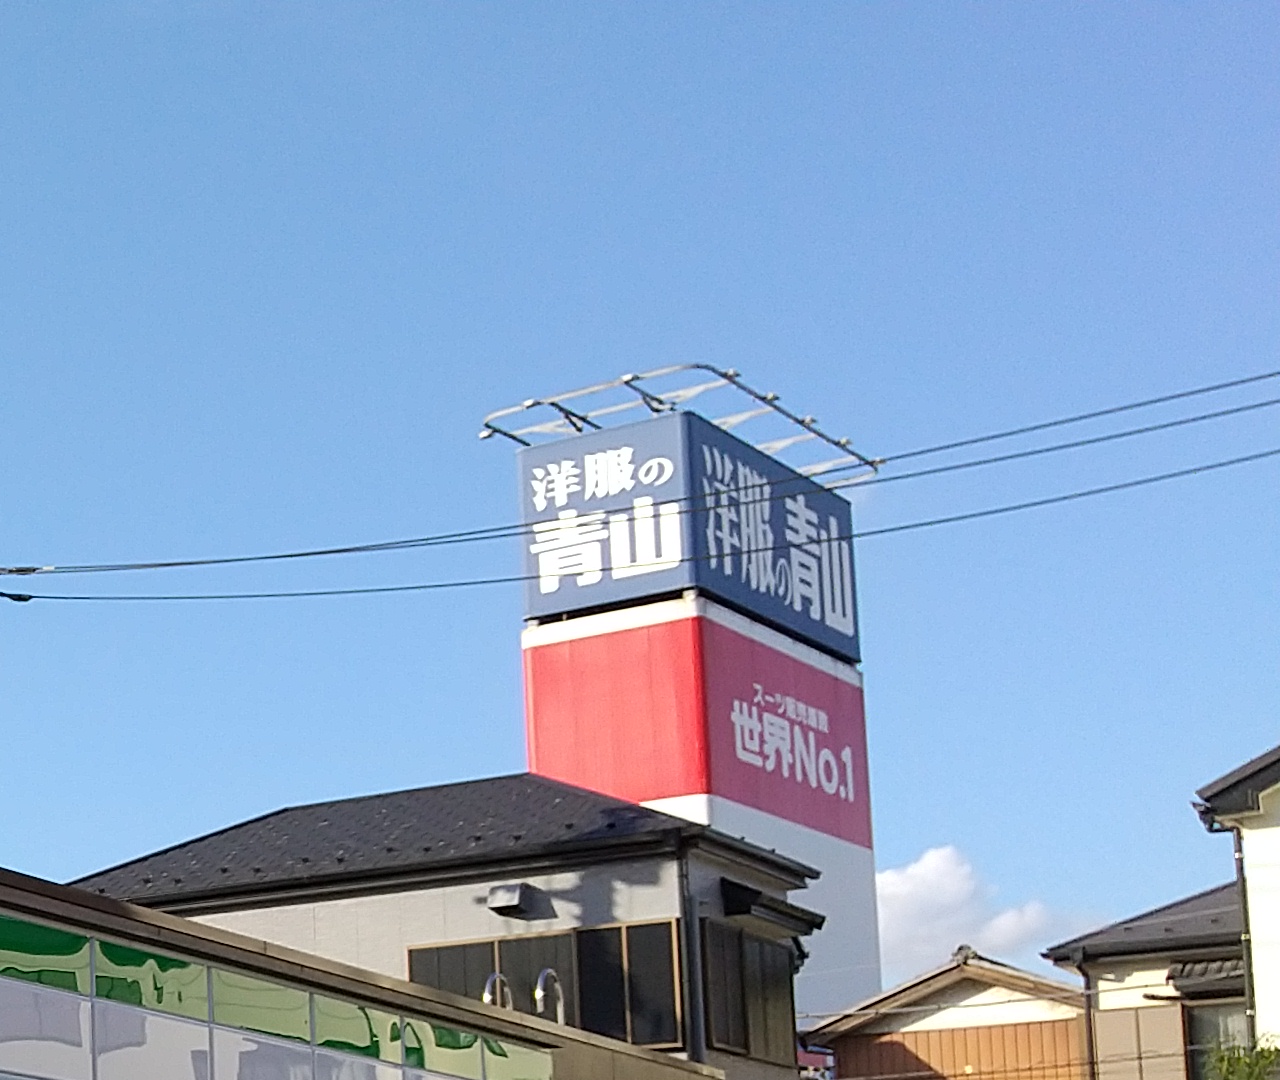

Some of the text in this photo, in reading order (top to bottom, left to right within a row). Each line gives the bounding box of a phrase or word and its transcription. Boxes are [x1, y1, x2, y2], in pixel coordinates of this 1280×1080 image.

[531, 446, 674, 512] 洋服の
[530, 496, 682, 594] 青山
[702, 444, 854, 638] 洋服の青山
